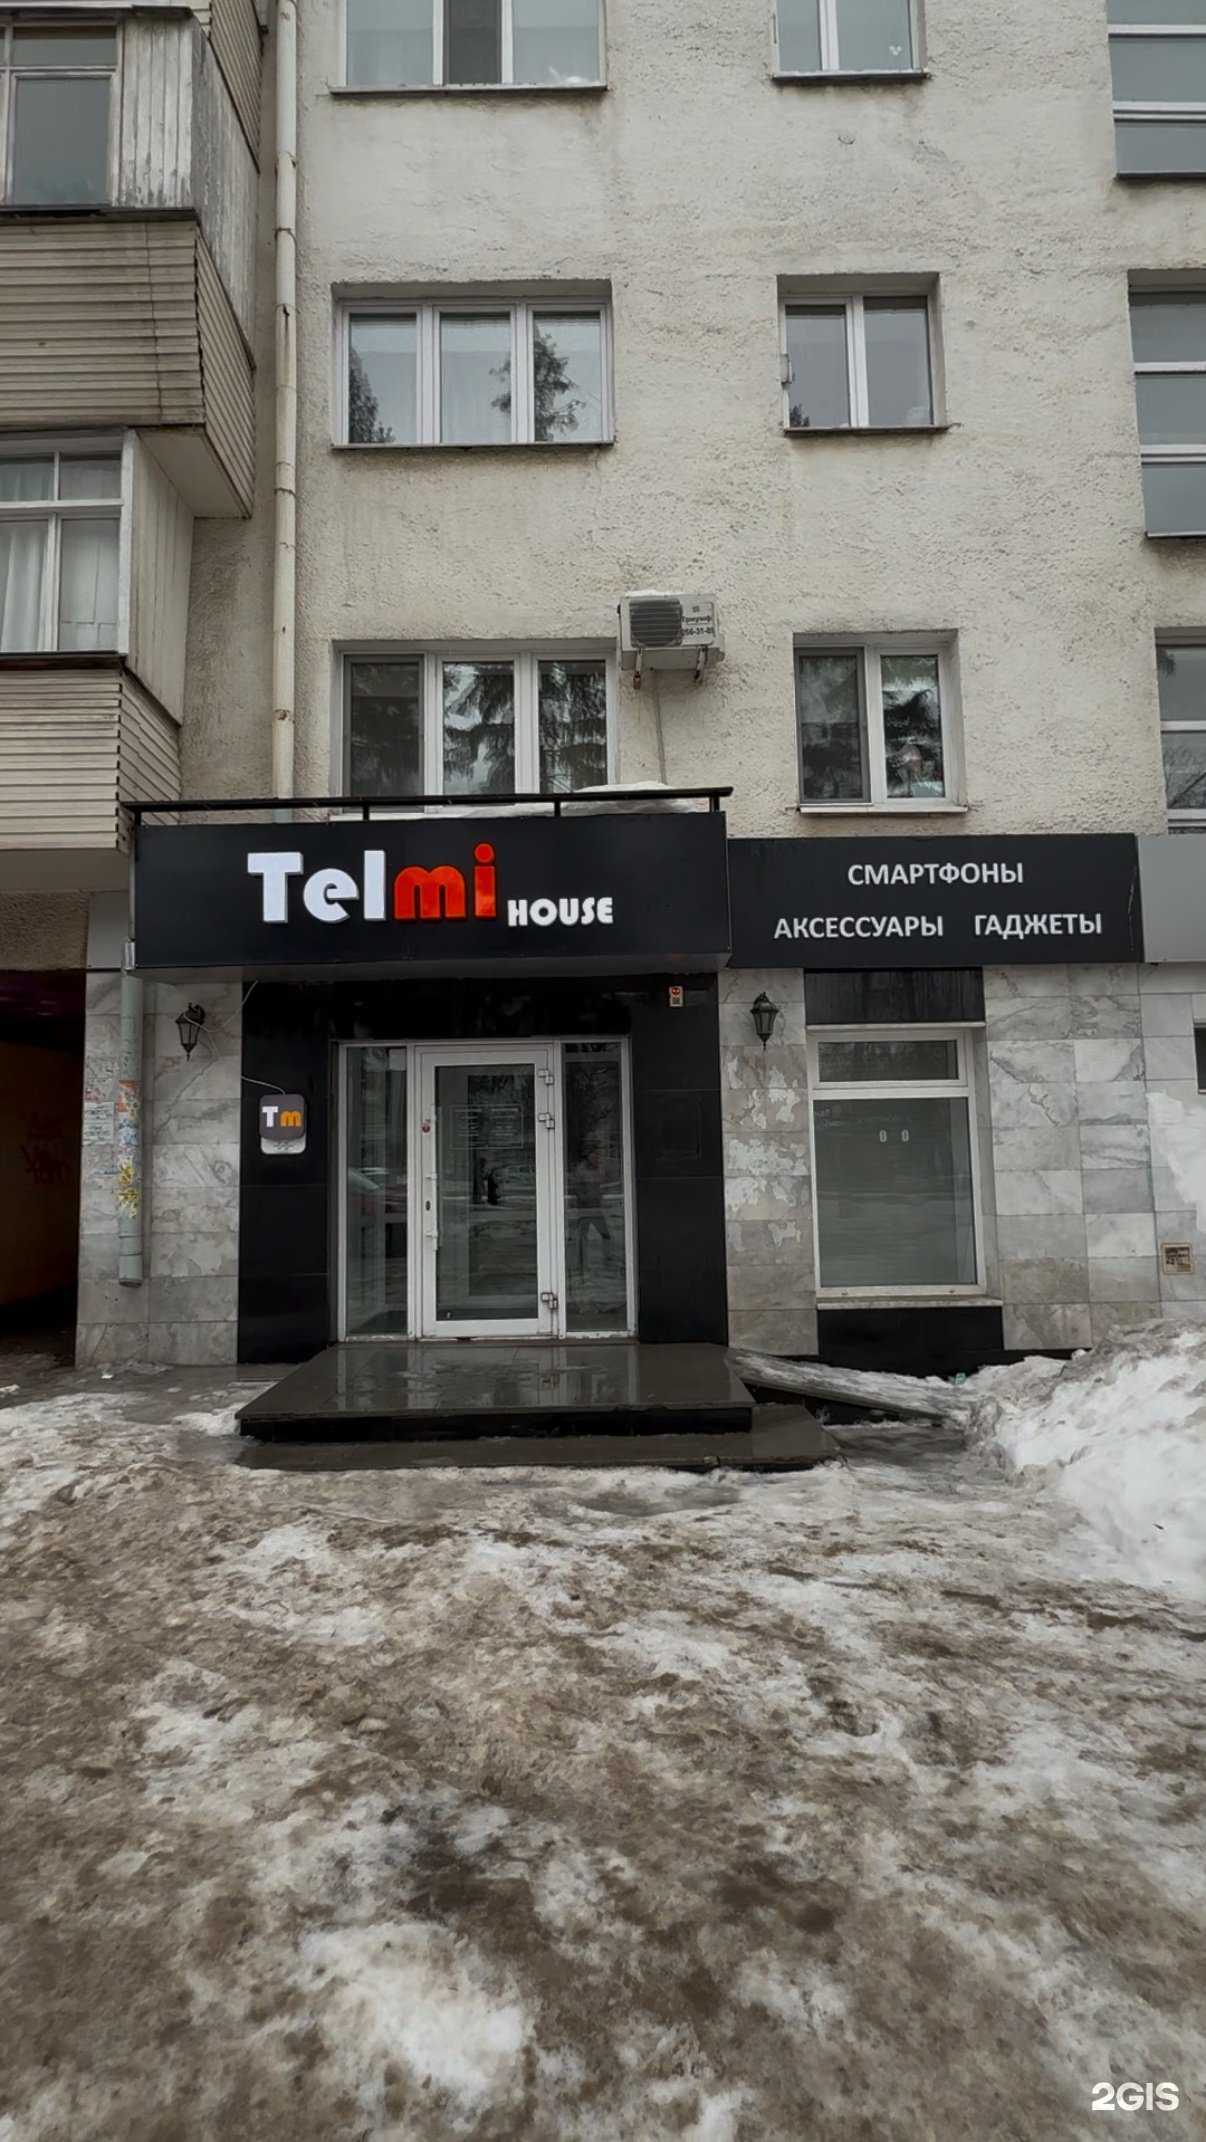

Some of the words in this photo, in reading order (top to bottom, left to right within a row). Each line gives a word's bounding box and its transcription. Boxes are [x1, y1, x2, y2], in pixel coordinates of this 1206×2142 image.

[247, 843, 497, 923] Telmi
[507, 897, 614, 927] HOUSE
[847, 862, 1024, 886] СМАРТФОНЫ
[773, 915, 944, 939] АКСЕССУАРЫ
[974, 913, 1102, 940] ГАДЖЕТЫ
